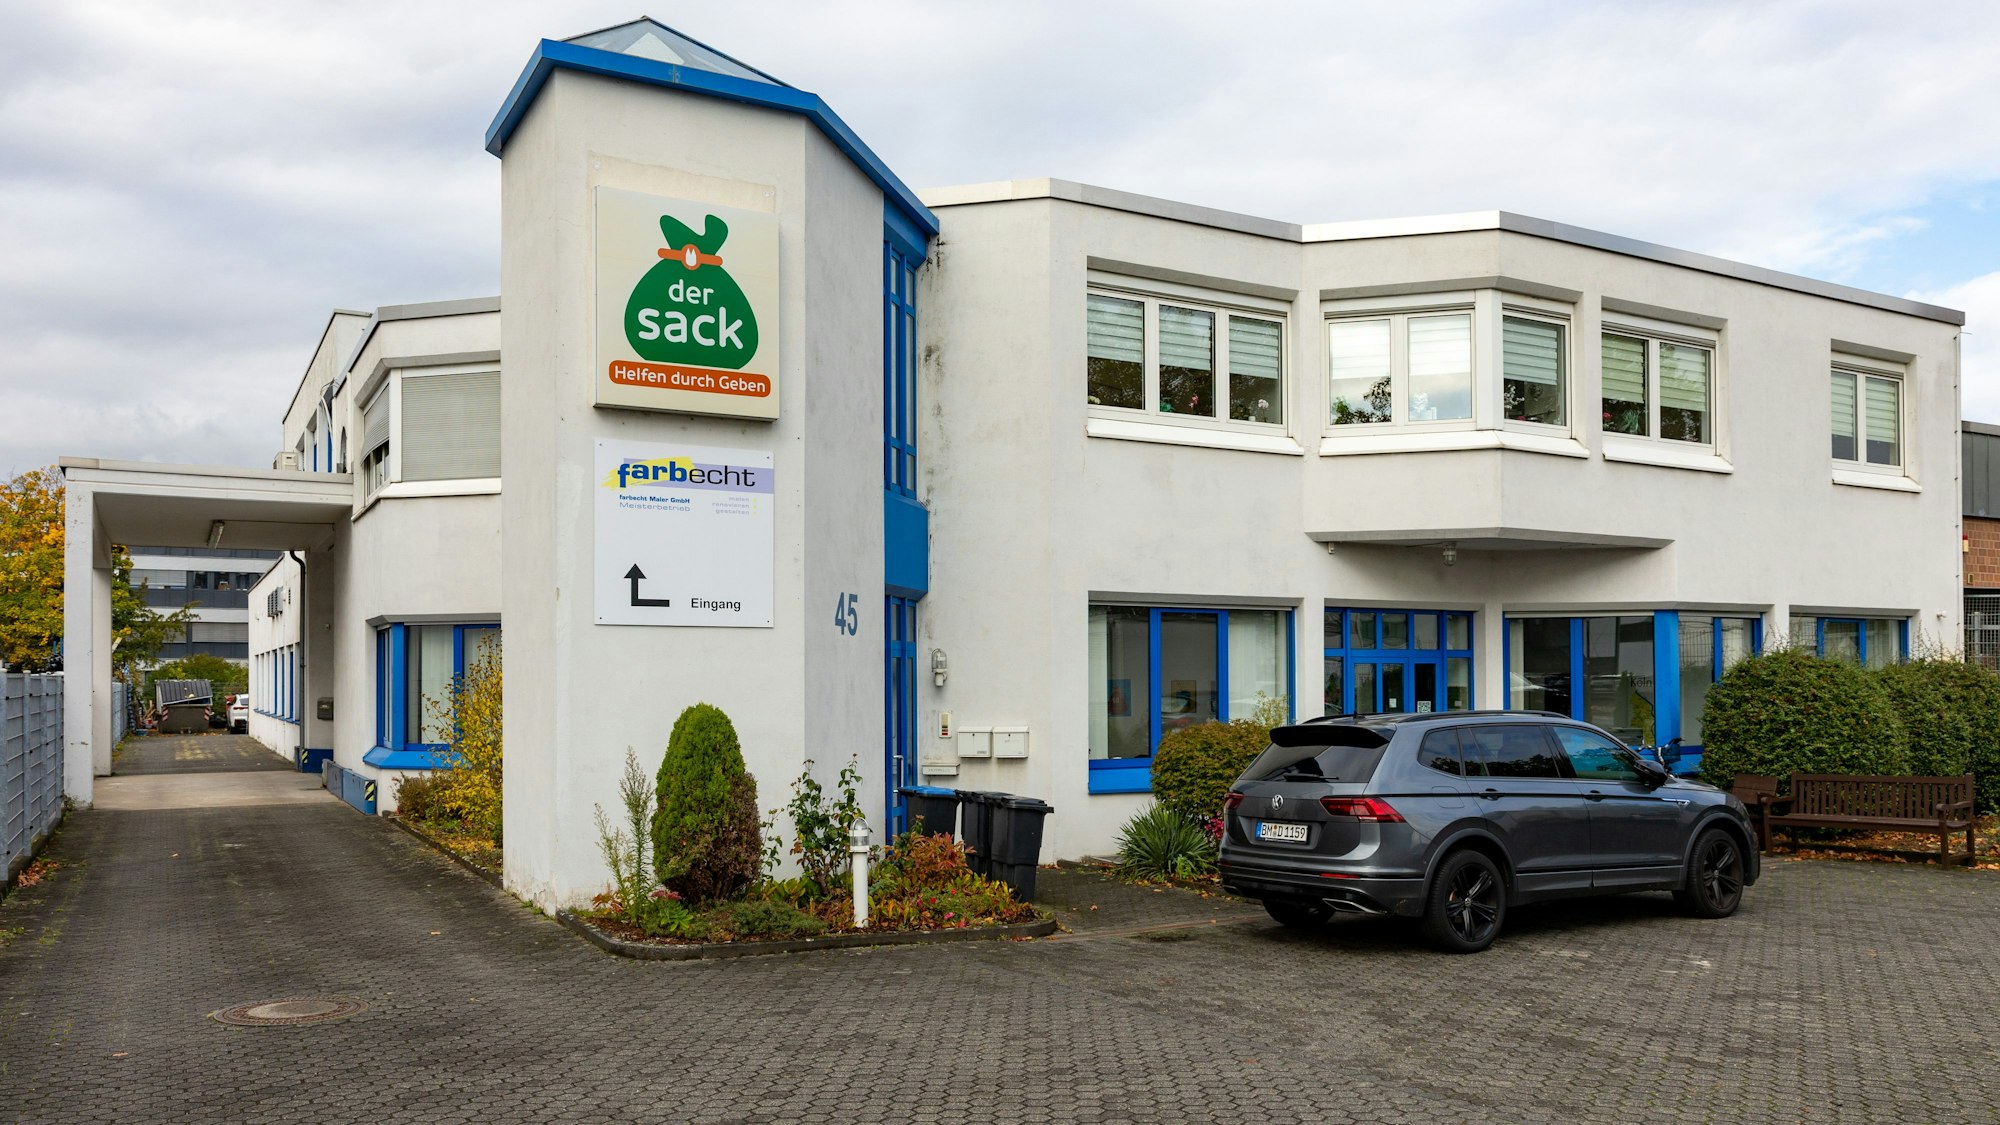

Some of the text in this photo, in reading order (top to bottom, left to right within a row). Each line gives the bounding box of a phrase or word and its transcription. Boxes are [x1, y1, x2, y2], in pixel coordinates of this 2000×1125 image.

[668, 279, 714, 305] der
[637, 306, 744, 350] sack
[614, 365, 766, 393] Helfen durch Geben
[617, 461, 756, 488] farbecht
[619, 494, 648, 502] farbecht
[619, 502, 691, 512] Meisterbetrieb
[691, 598, 741, 612] Eingang
[834, 591, 858, 637] 45
[1261, 824, 1273, 837] BM
[1284, 826, 1306, 839] 1159
